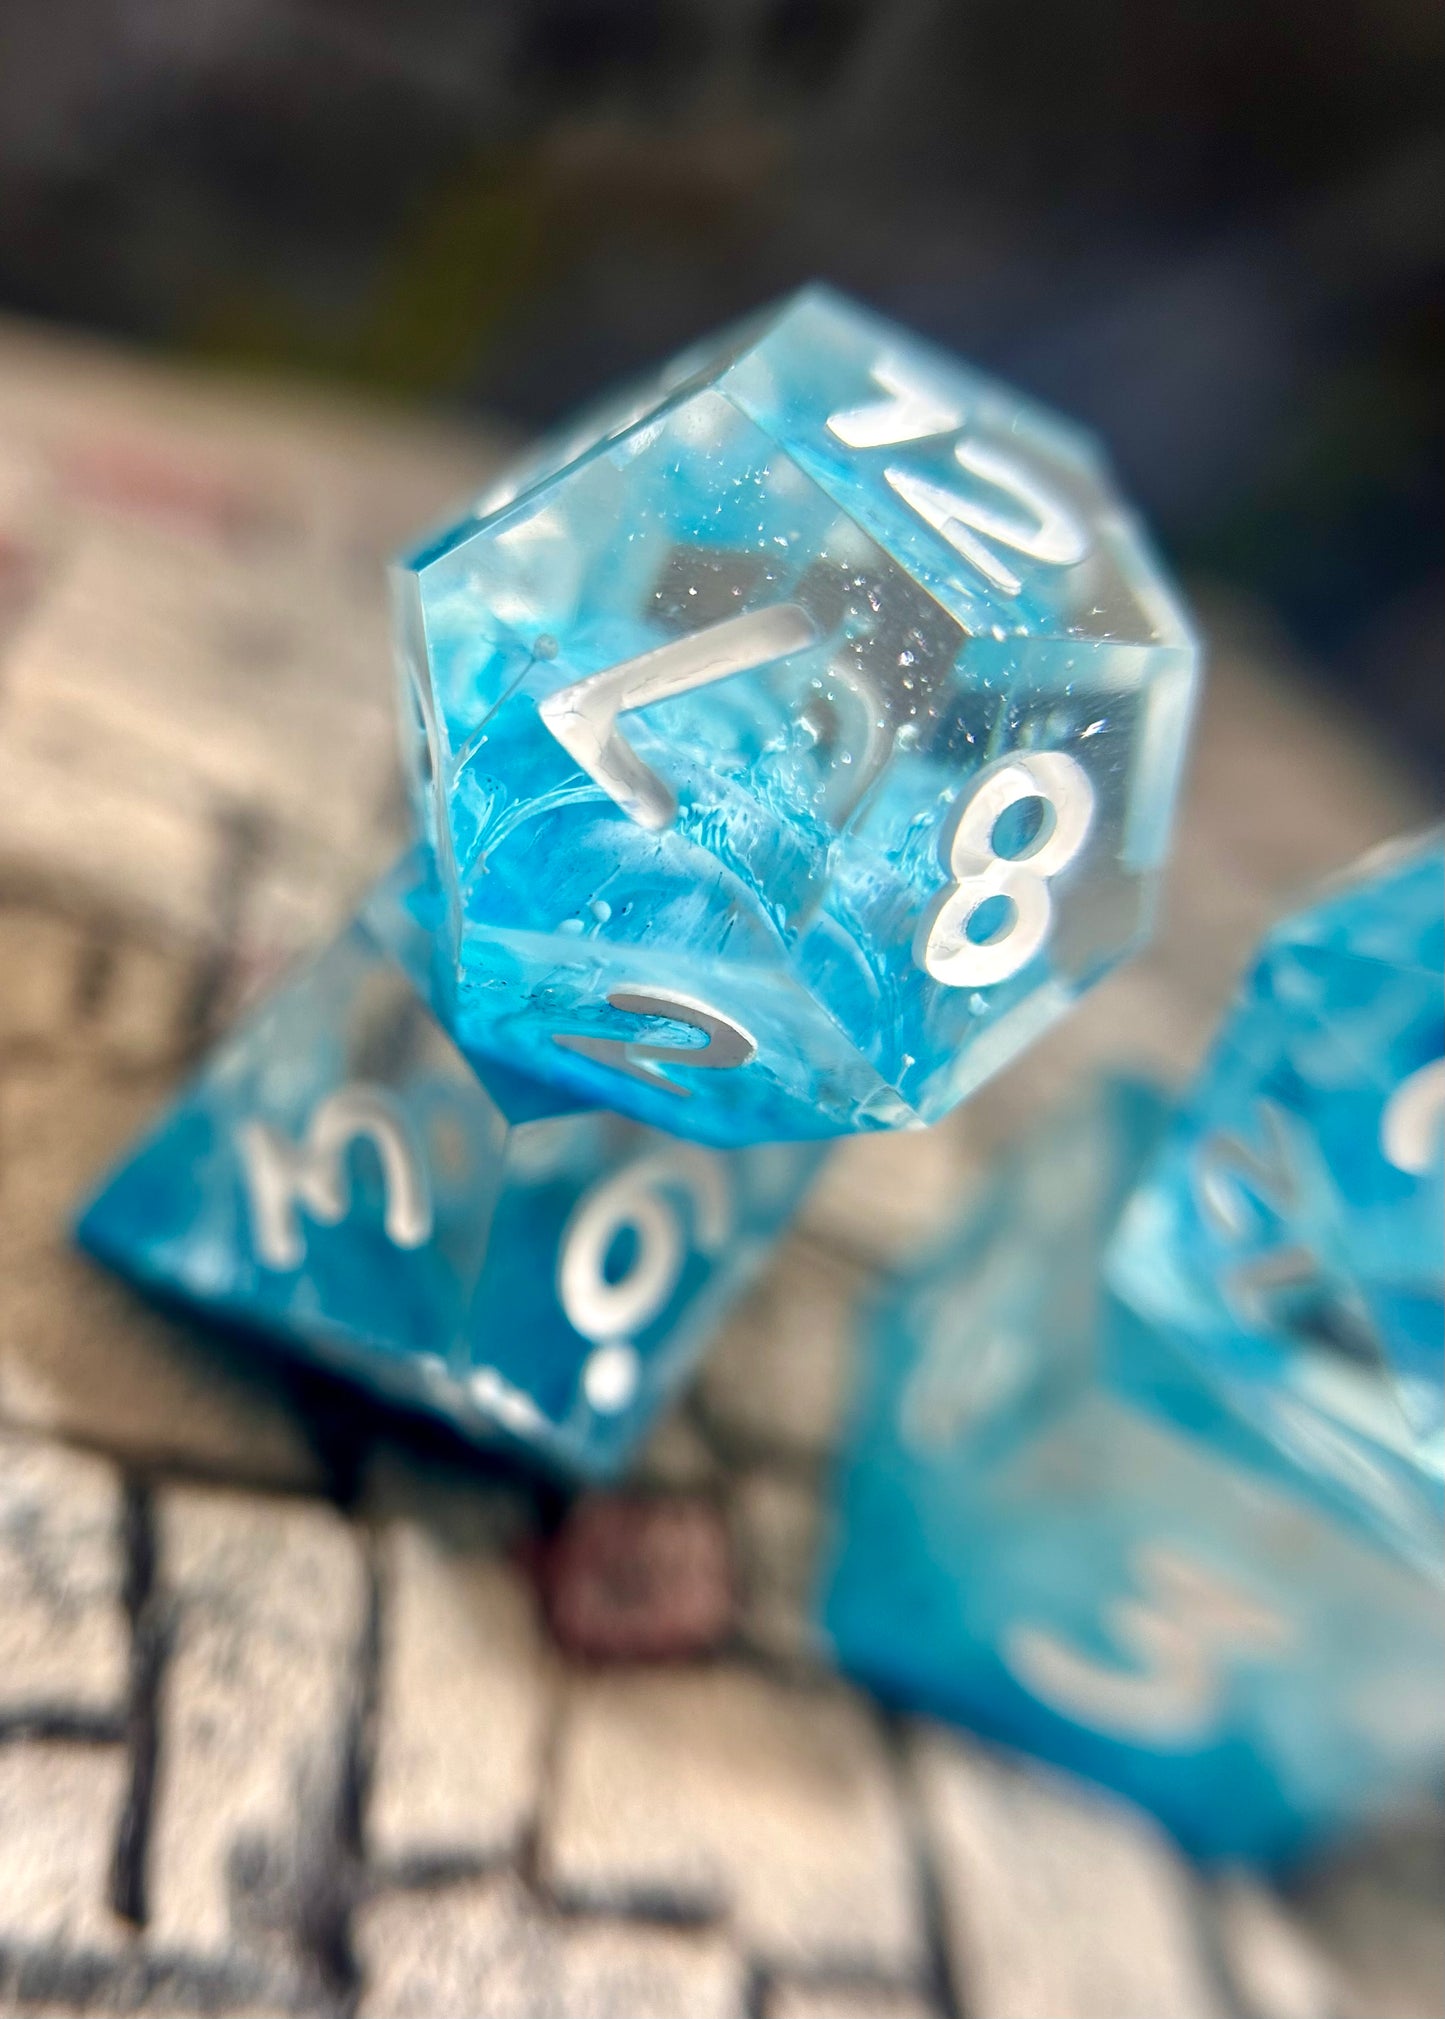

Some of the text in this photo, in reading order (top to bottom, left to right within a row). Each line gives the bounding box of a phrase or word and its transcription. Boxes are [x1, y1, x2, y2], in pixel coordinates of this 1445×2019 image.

[825, 352, 1090, 596] 12
[539, 602, 820, 830] 7
[918, 749, 1096, 988] 8
[551, 983, 758, 1098] 2
[236, 1083, 432, 1270] 3
